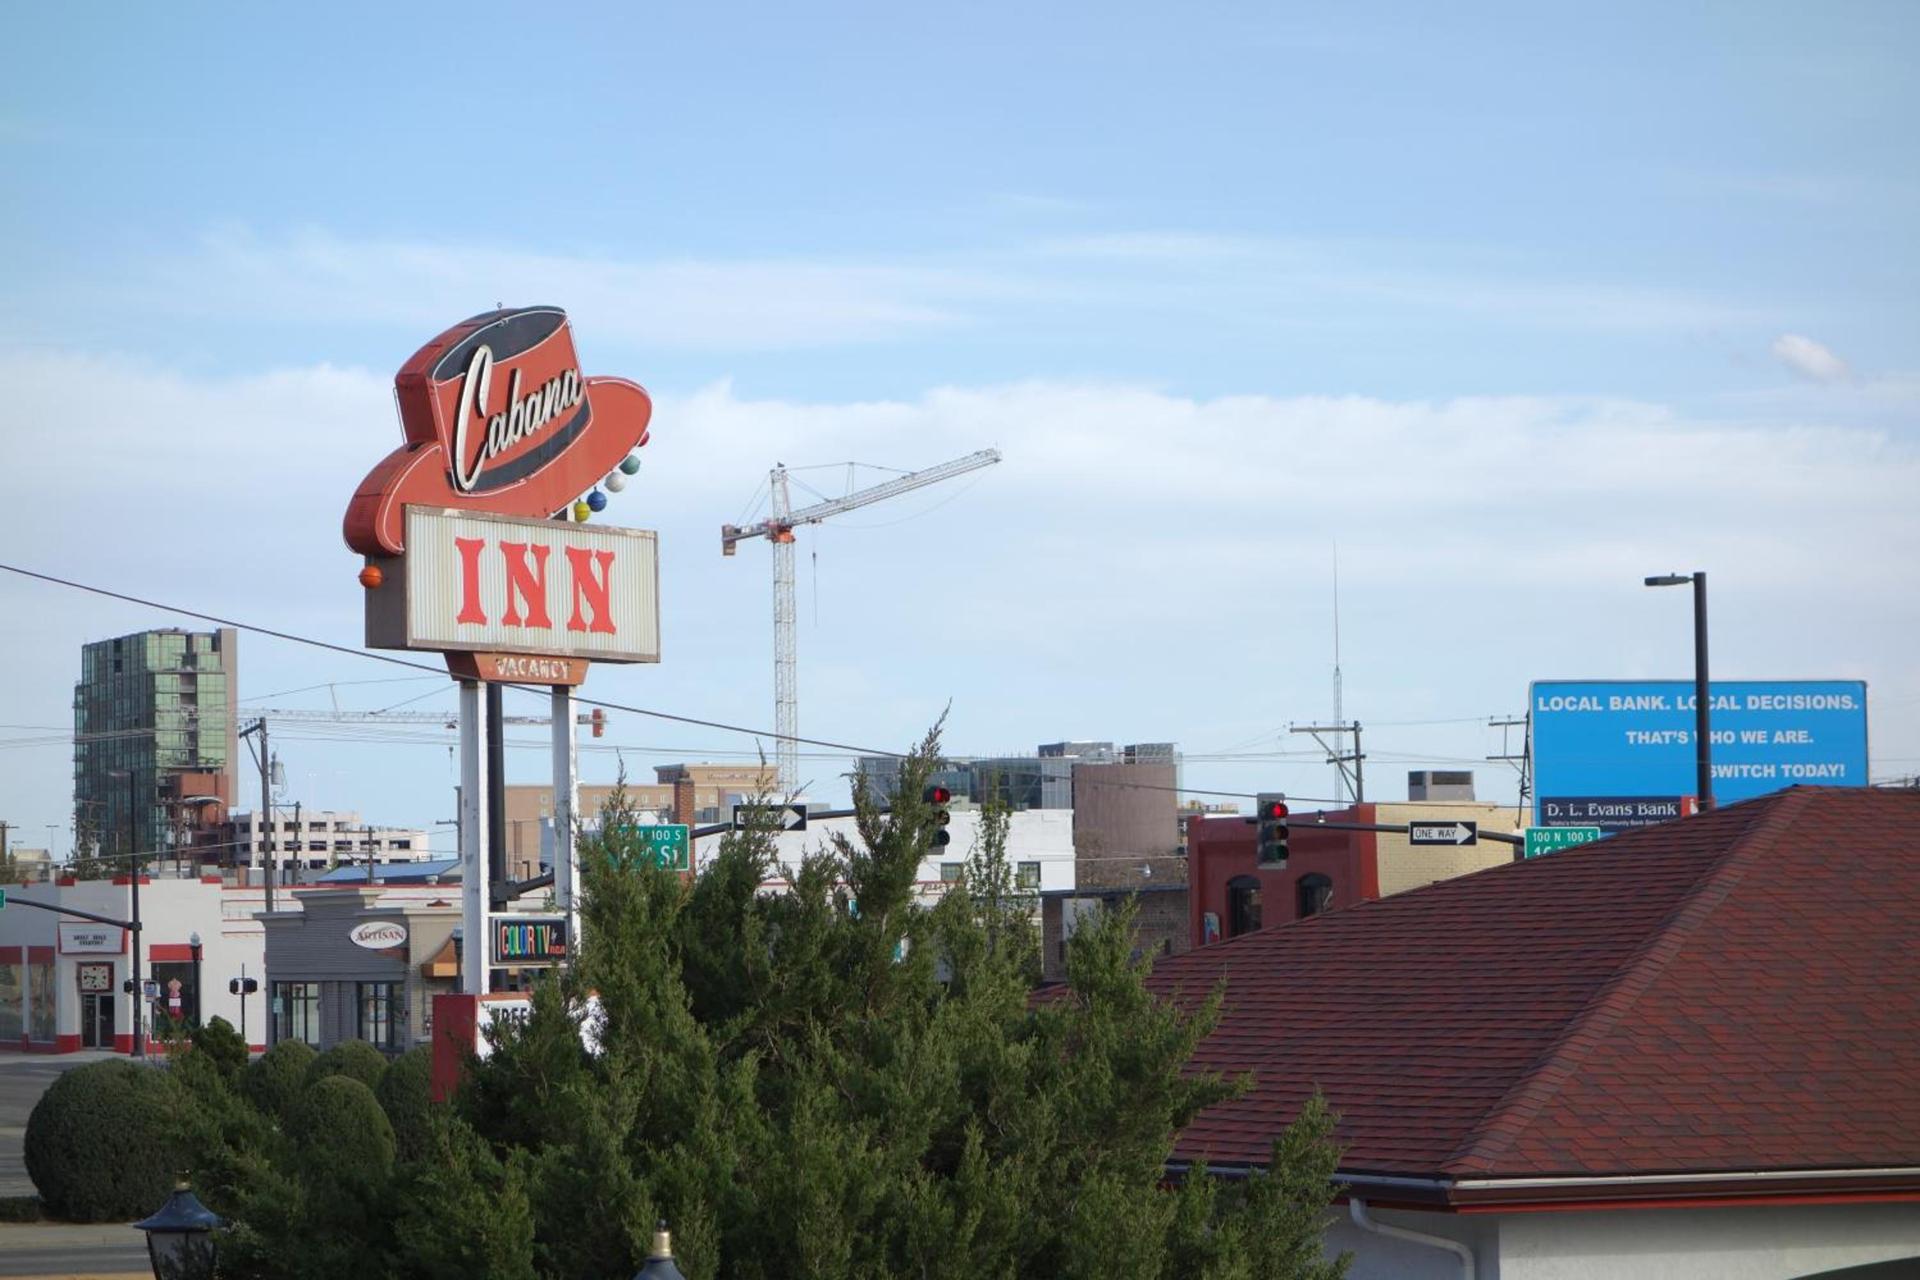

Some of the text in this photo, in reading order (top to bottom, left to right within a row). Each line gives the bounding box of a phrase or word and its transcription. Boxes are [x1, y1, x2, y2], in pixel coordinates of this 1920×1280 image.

[455, 345, 583, 490] Cabana
[454, 537, 617, 635] INN
[497, 657, 572, 679] VACANCY
[1538, 696, 1603, 711] LOCAL
[1609, 696, 1671, 710] BANK.
[1746, 694, 1859, 710] DECISIONS.
[1625, 730, 1814, 744] THAT'S HO WE ARE.
[1781, 763, 1845, 778] TODAY!
[1547, 802, 1677, 816] D. L. Evans Bank
[652, 830, 671, 841] 100
[675, 830, 681, 841] S
[1415, 829, 1456, 838] ONE WAY
[1533, 832, 1593, 842] 100 N 100 S
[501, 925, 535, 956] COLOR
[535, 924, 550, 954] TV
